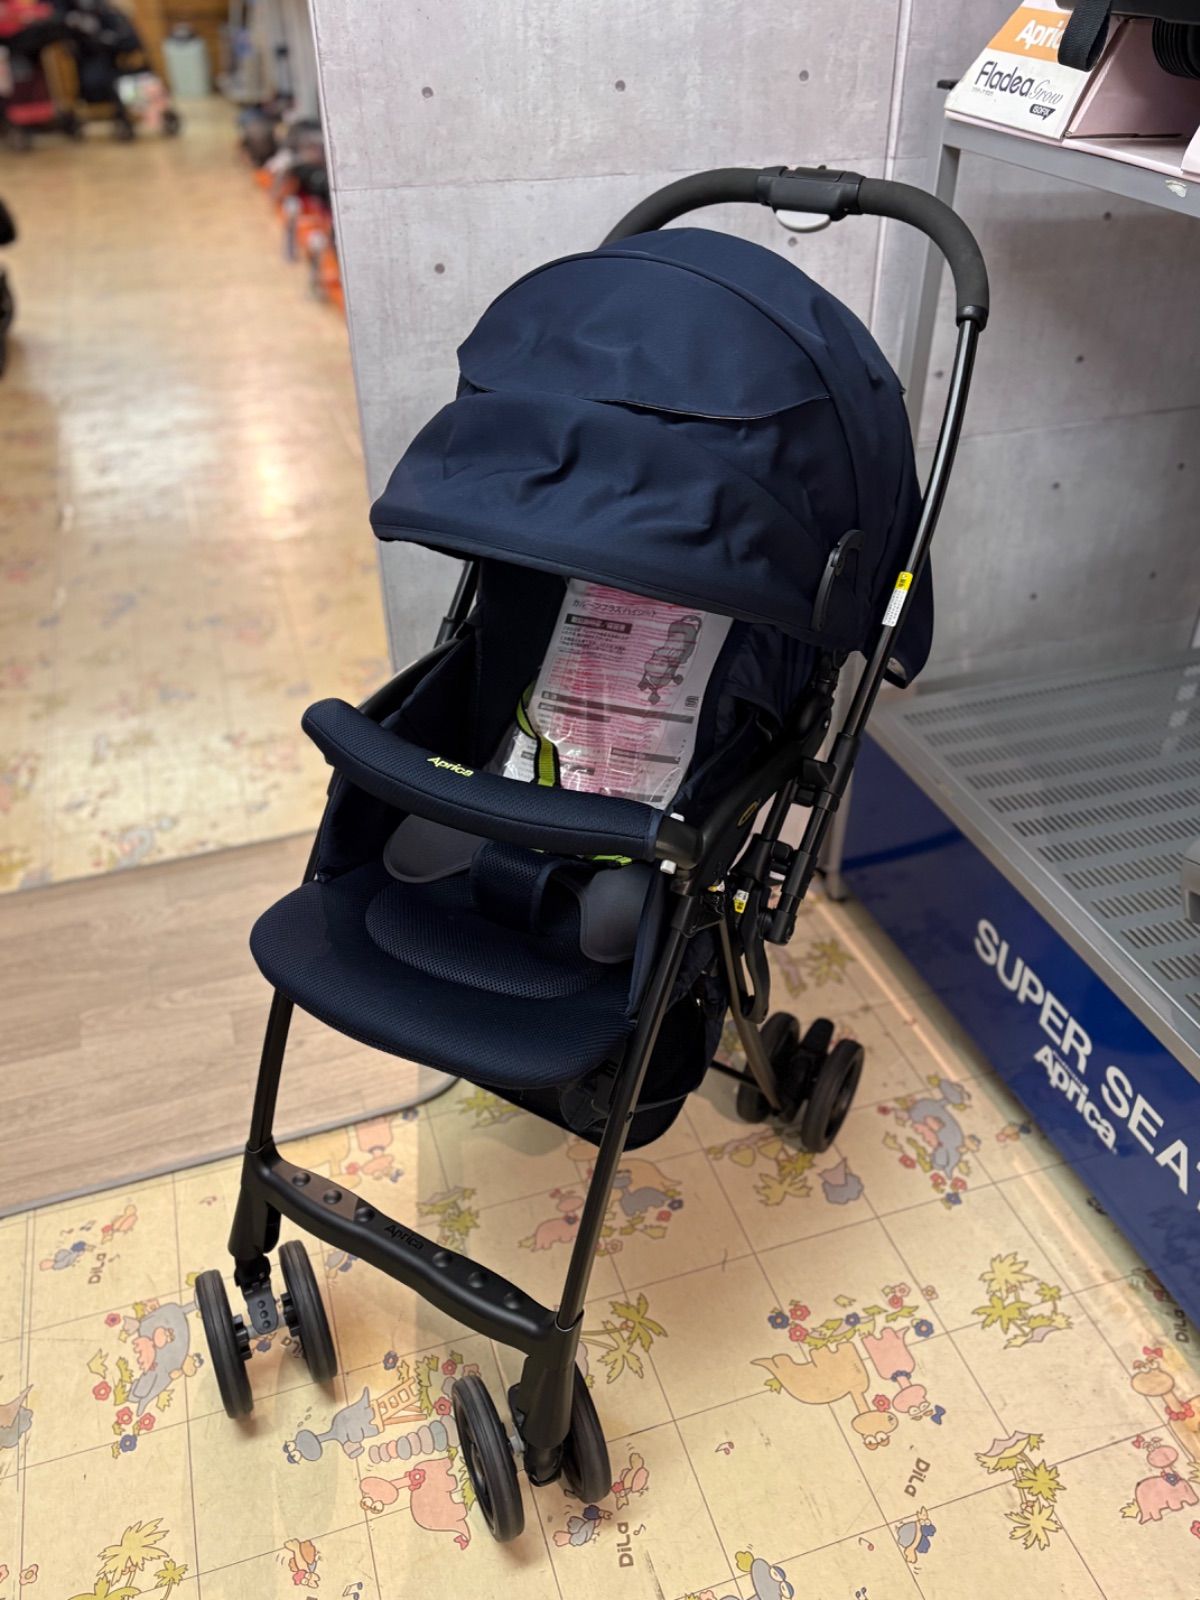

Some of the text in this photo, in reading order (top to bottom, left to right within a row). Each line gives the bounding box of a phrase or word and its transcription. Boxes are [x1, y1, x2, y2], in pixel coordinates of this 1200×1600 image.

[974, 60, 1035, 97] Fladea
[426, 756, 475, 778] Aprica
[974, 919, 1200, 1213] SUPER SEA
[1033, 1044, 1116, 1150] Aprica
